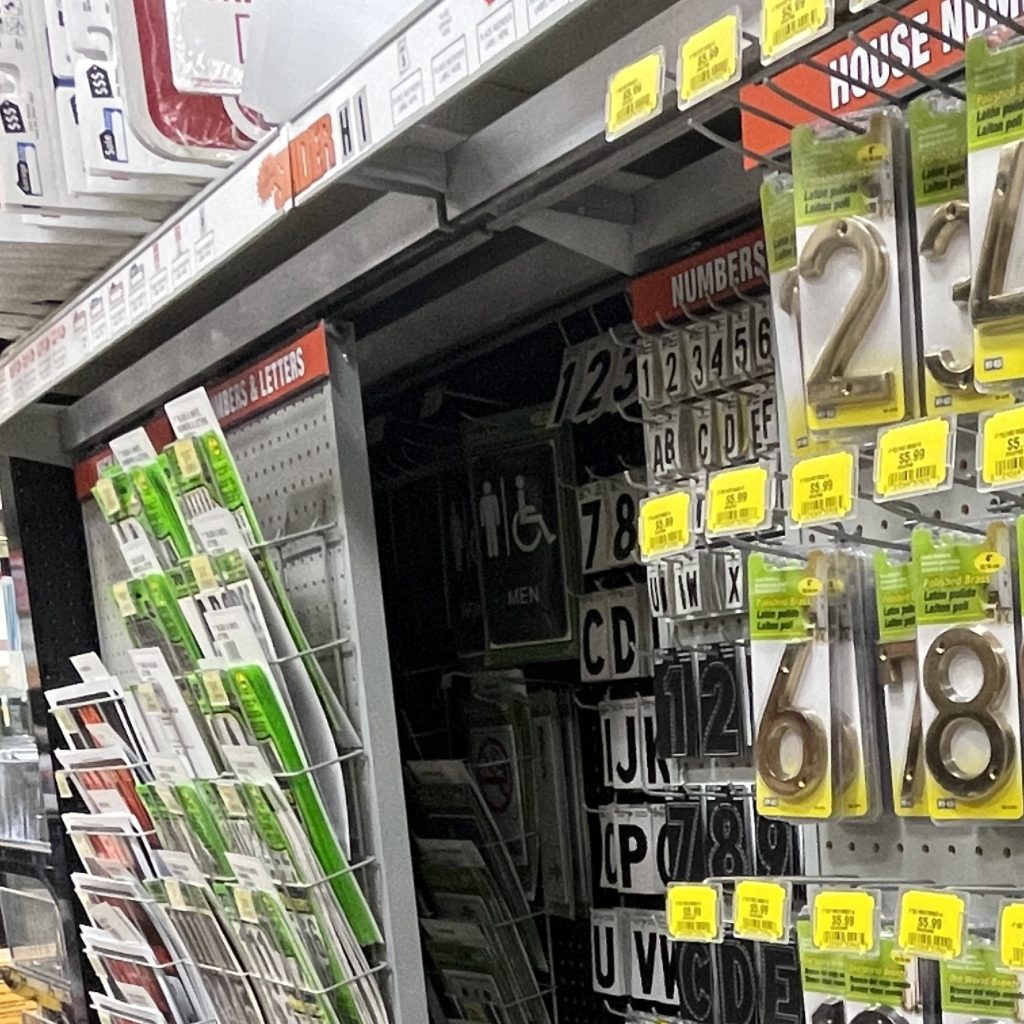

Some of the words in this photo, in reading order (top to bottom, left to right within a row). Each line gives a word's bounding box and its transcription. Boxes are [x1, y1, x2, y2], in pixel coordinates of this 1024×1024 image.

[828, 12, 931, 110] HOUSE
[671, 241, 765, 307] NUMBERS
[800, 216, 890, 407] 2
[259, 346, 305, 393] LETTERS
[577, 350, 611, 415] 2
[698, 423, 708, 465] C
[725, 414, 735, 452] D
[752, 410, 761, 450] E
[899, 448, 925, 465] $5.99
[580, 501, 600, 571] 7
[614, 493, 636, 560] 8
[728, 566, 740, 604] X
[583, 609, 606, 675] C
[612, 606, 637, 674] D
[663, 665, 687, 758] 1
[701, 661, 740, 756] 2
[758, 639, 833, 800] 6
[923, 627, 1016, 799] 8
[616, 716, 638, 784] J
[619, 823, 648, 888] P
[709, 803, 748, 880] 8
[918, 917, 943, 930] $5.99
[595, 926, 615, 989] U
[634, 931, 656, 995] V
